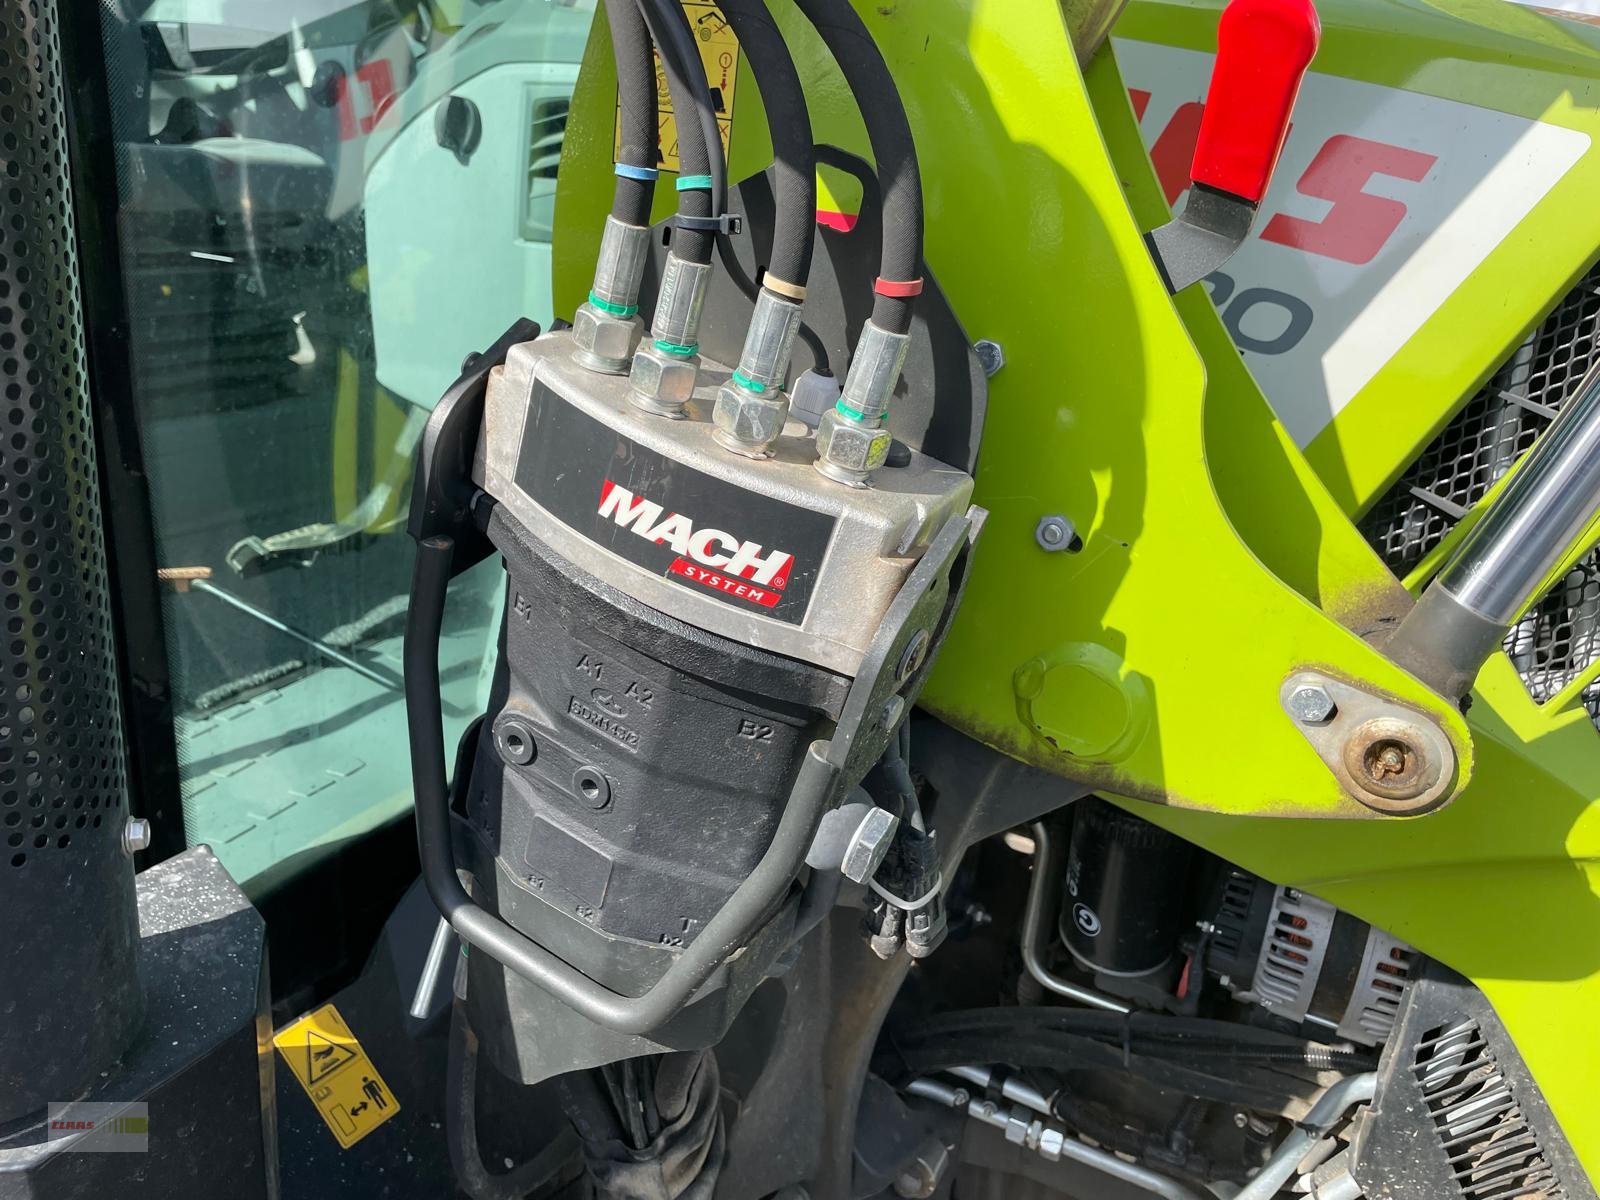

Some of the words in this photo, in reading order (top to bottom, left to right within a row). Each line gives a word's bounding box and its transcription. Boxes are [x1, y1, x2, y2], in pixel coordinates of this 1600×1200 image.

[598, 483, 791, 586] MACH
[684, 566, 764, 601] SYSTEM
[514, 592, 531, 623] B1
[576, 654, 603, 682] A1
[625, 682, 653, 710] A2
[733, 718, 775, 744] B2
[680, 915, 698, 933] T
